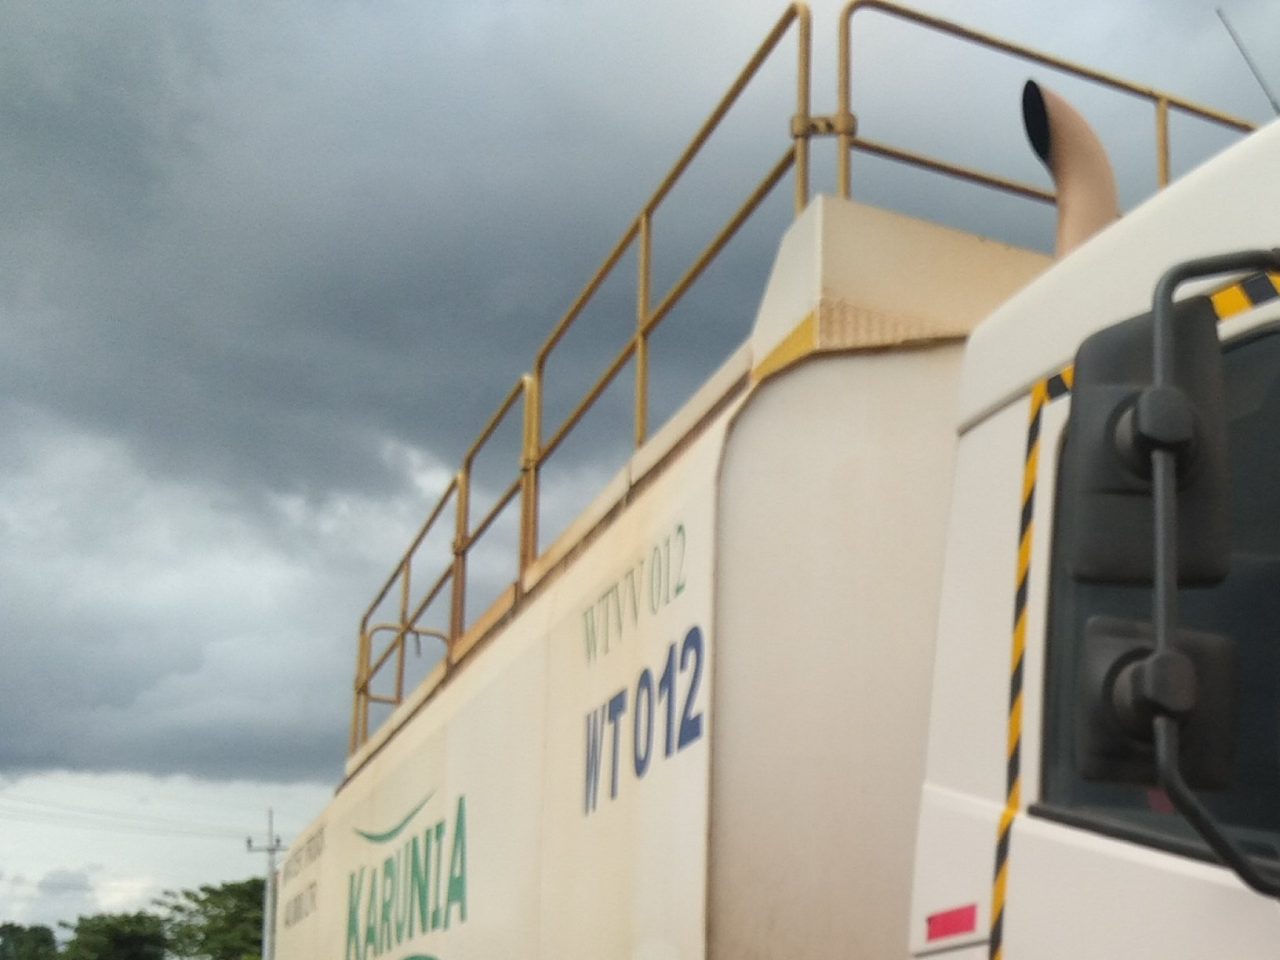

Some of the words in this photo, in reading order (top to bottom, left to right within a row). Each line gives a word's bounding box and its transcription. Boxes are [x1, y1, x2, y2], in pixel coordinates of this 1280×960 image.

[649, 523, 687, 616] 012
[584, 687, 628, 816] WT
[632, 625, 705, 780] 012
